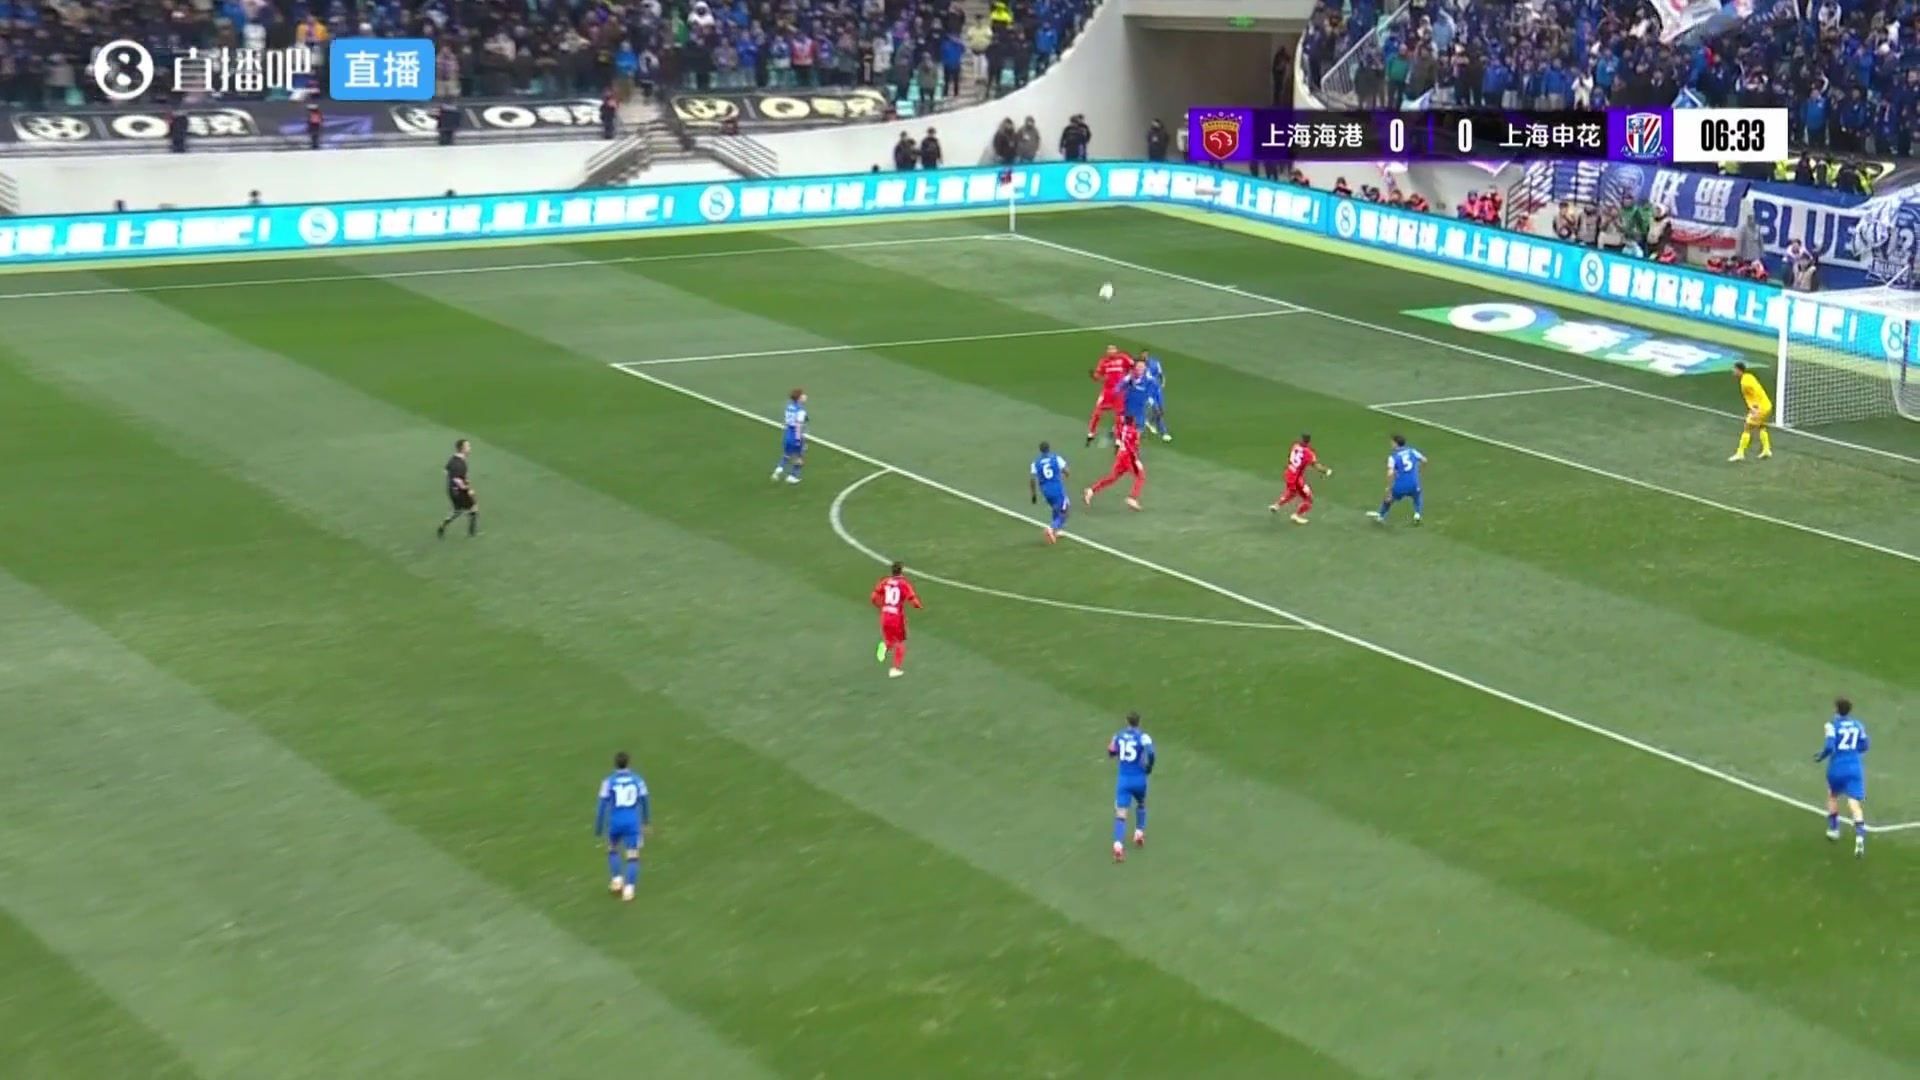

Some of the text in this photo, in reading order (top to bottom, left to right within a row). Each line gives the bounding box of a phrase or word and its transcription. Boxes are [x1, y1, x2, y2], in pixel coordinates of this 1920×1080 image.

[1753, 198, 1861, 262] BLUE
[1043, 463, 1054, 479] 6
[1402, 455, 1413, 472] 5
[885, 585, 900, 606] 10
[1838, 727, 1859, 750] 27
[1118, 739, 1137, 762] 15
[612, 783, 638, 807] 10
